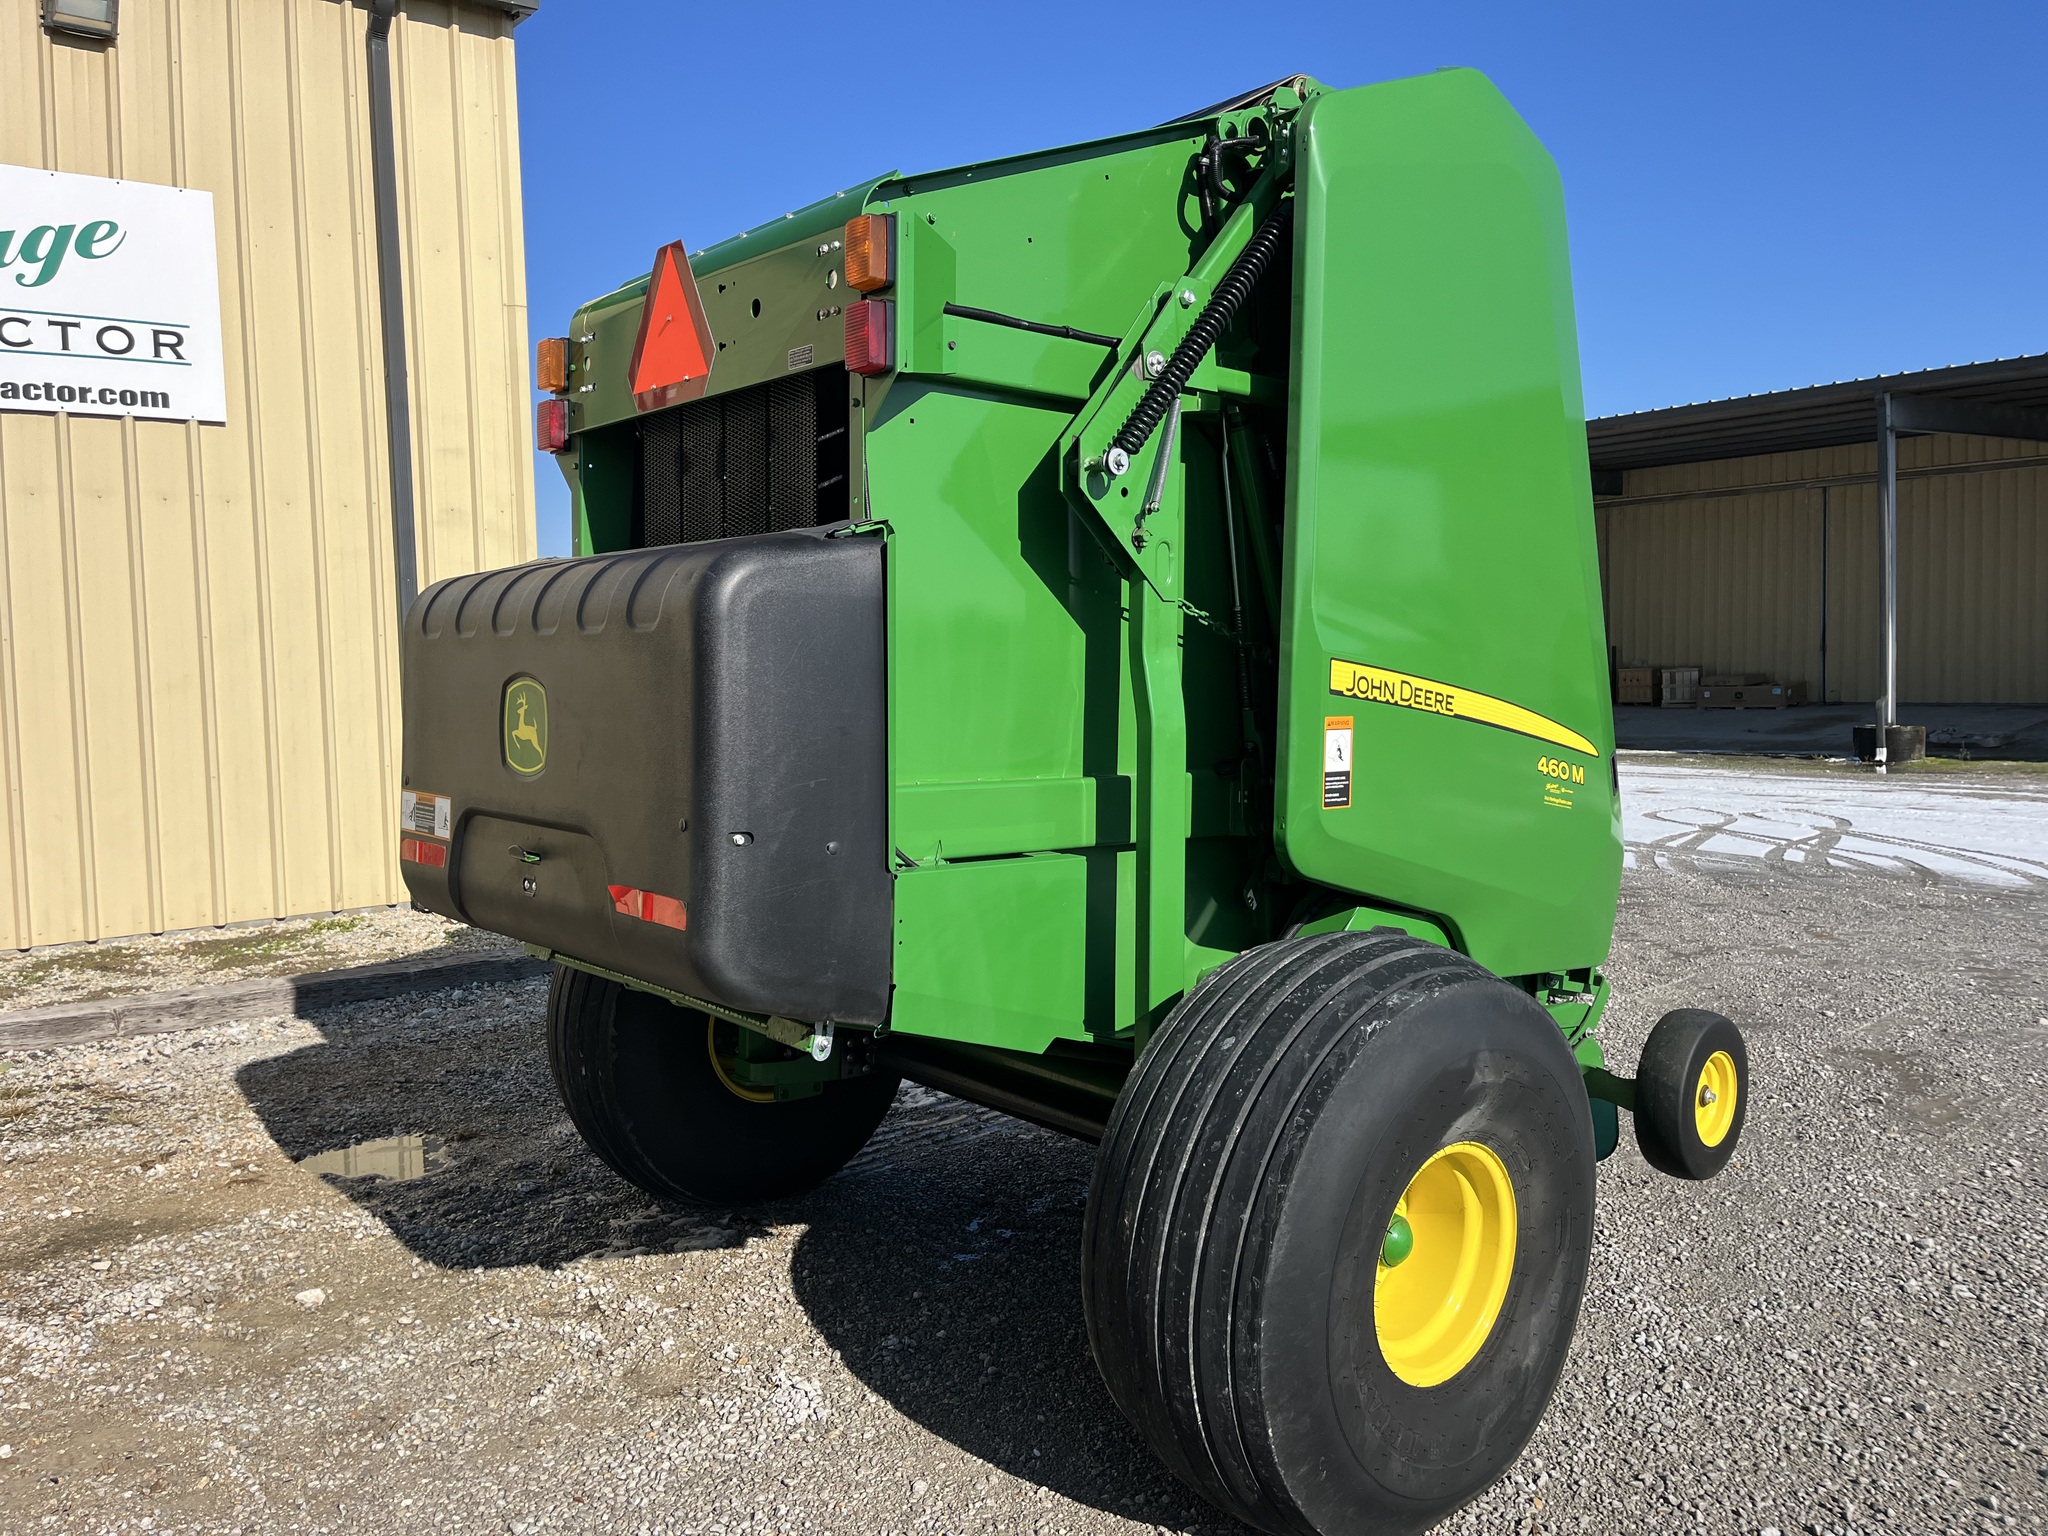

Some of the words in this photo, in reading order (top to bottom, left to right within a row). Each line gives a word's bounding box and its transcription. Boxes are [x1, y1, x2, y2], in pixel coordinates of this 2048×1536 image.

[0, 317, 187, 360] CTOR
[0, 381, 170, 409] actor.com
[1346, 670, 1395, 699] JOHN
[1399, 679, 1455, 713] DEERE
[1537, 756, 1570, 781] 460
[1571, 764, 1585, 785] M
